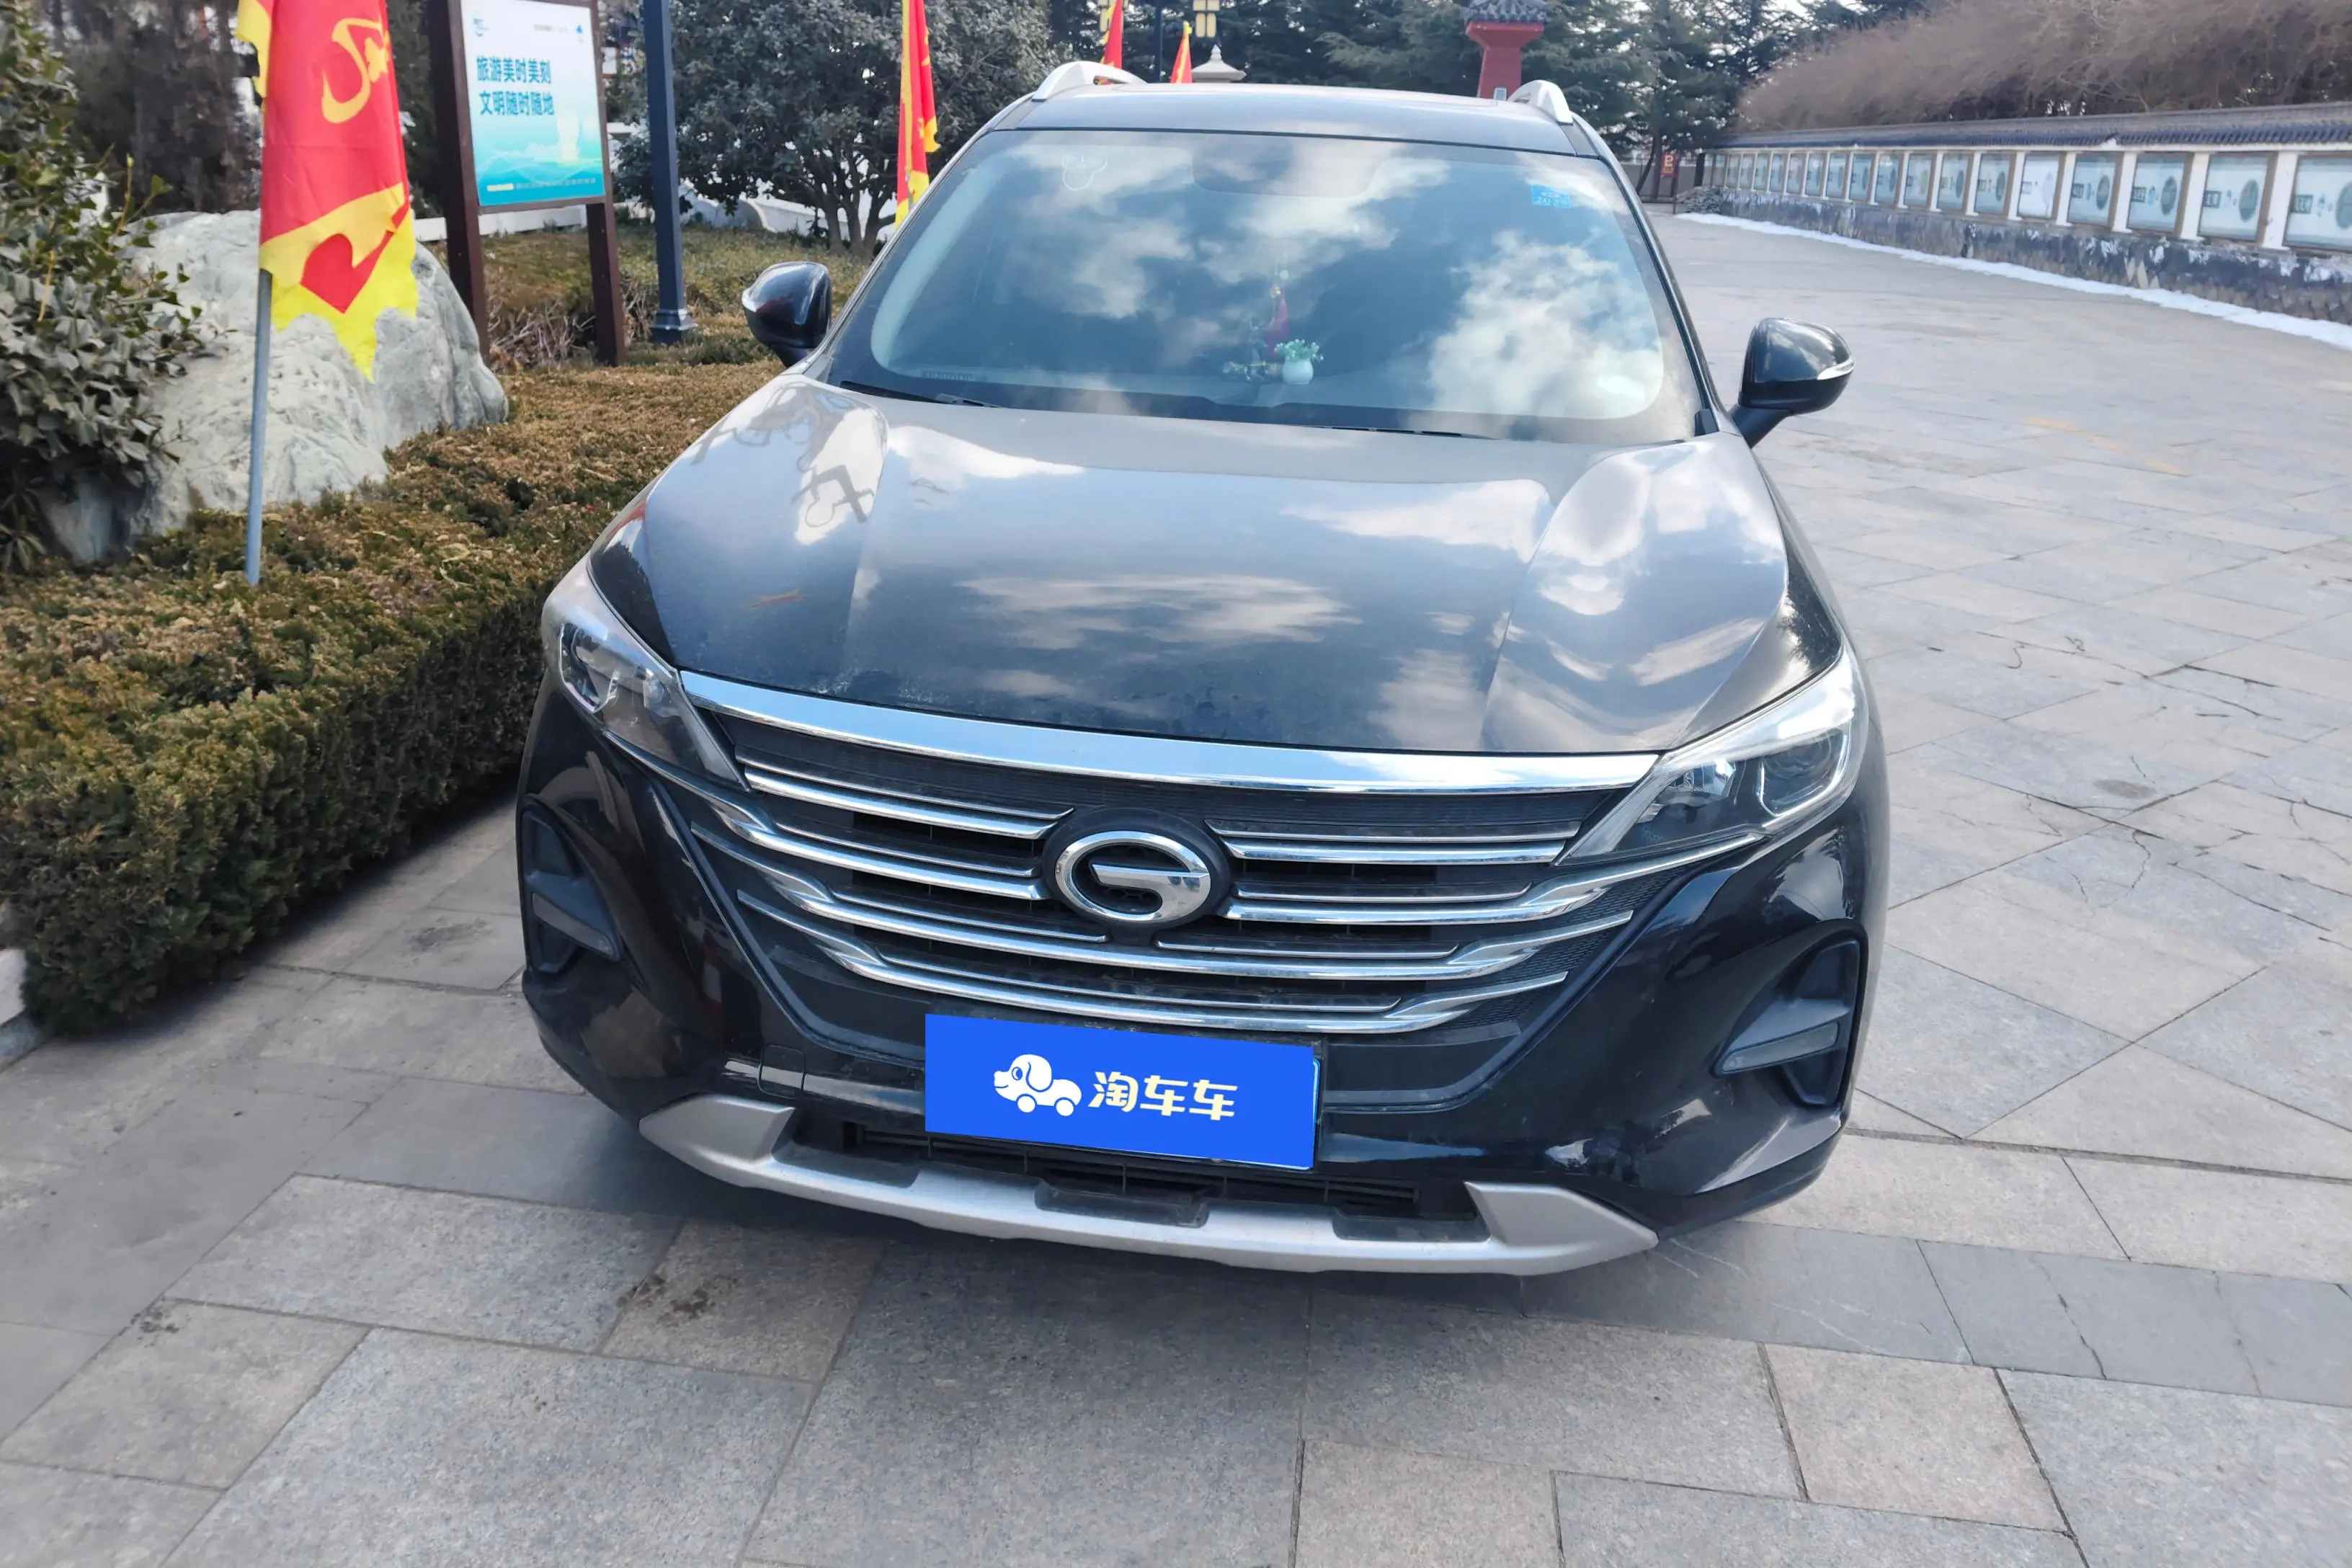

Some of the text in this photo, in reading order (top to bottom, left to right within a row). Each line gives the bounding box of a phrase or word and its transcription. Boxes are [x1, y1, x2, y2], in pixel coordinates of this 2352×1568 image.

[476, 56, 551, 84] 旅游美时美刻
[478, 90, 554, 115] 文明随时随地
